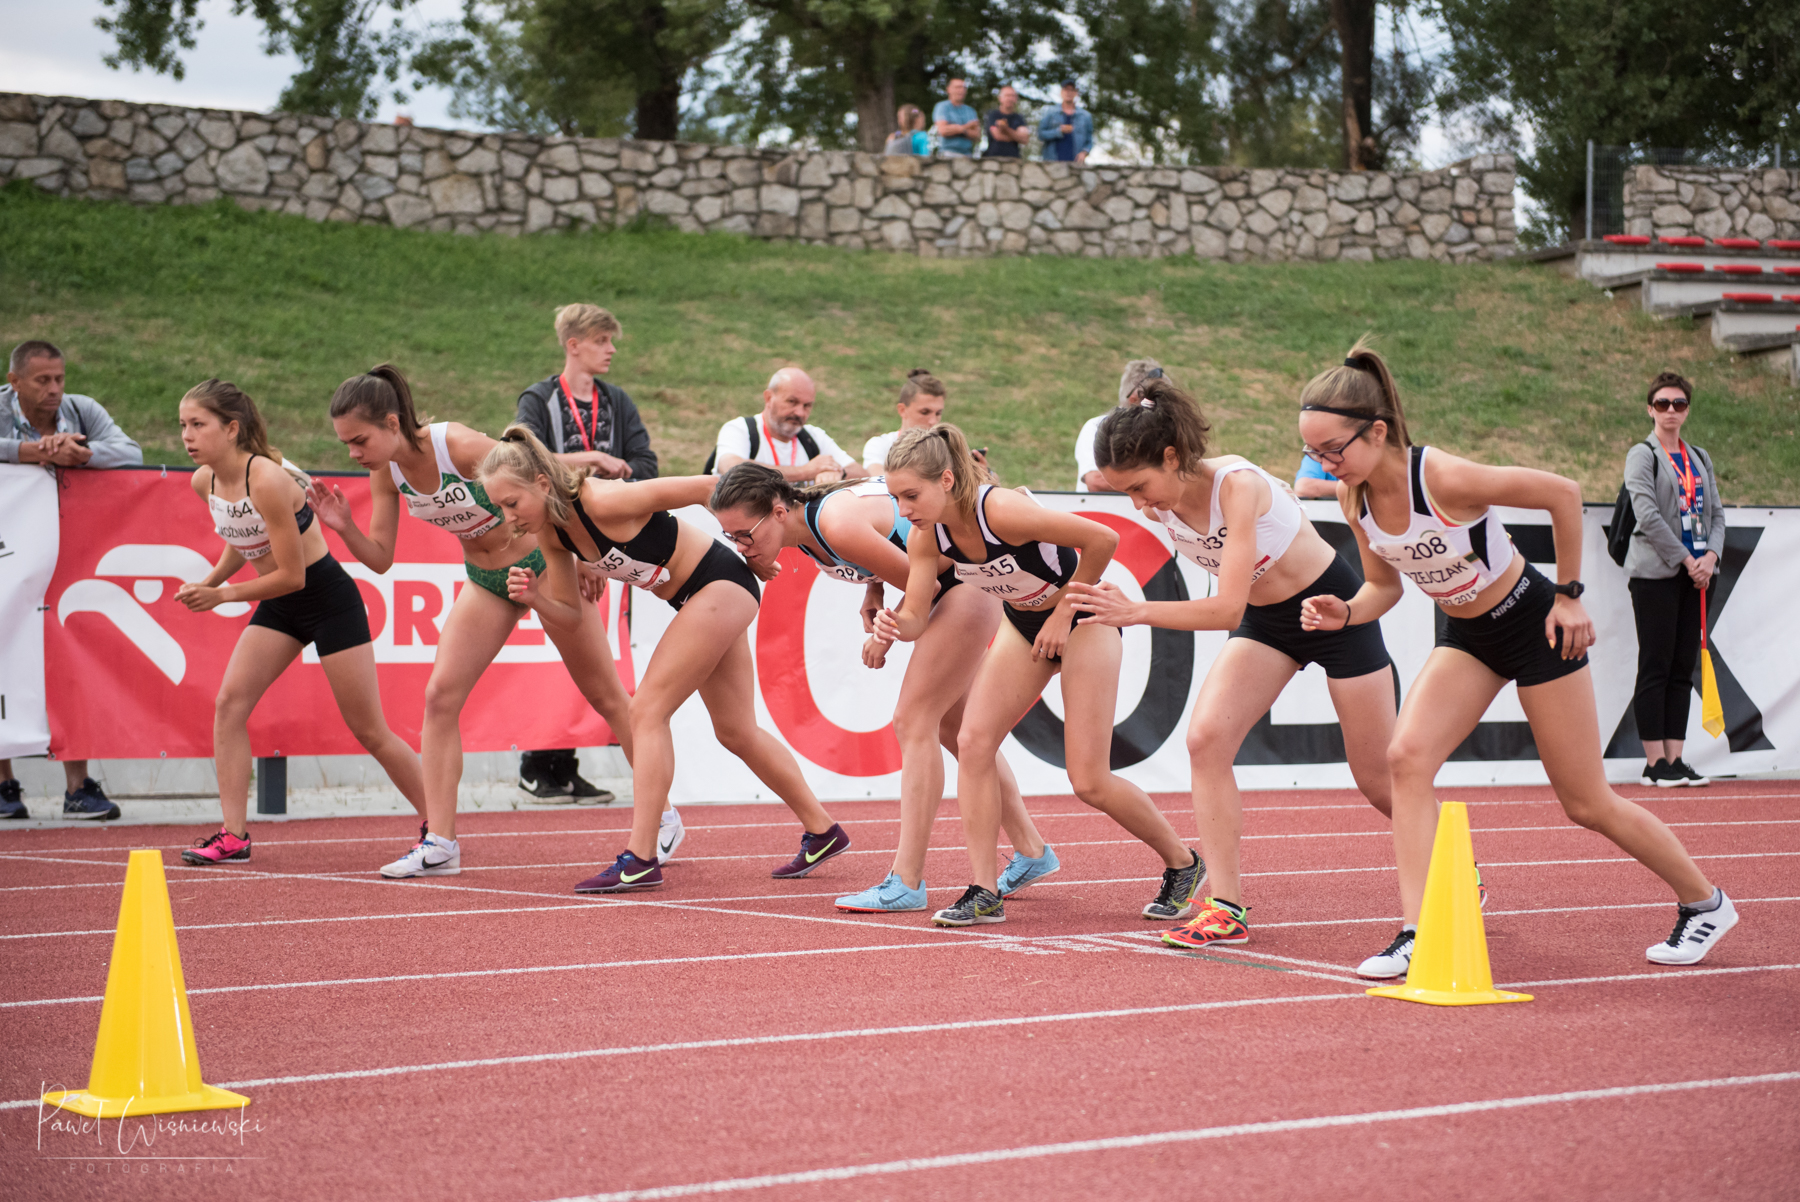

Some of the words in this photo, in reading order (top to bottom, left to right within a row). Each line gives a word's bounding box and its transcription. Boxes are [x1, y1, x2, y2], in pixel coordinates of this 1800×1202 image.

[432, 487, 466, 508] 540
[227, 501, 253, 518] 664
[1404, 536, 1447, 560] 208
[979, 558, 1015, 577] 515
[1490, 595, 1517, 619] NIKE
[1513, 576, 1531, 599] PRO
